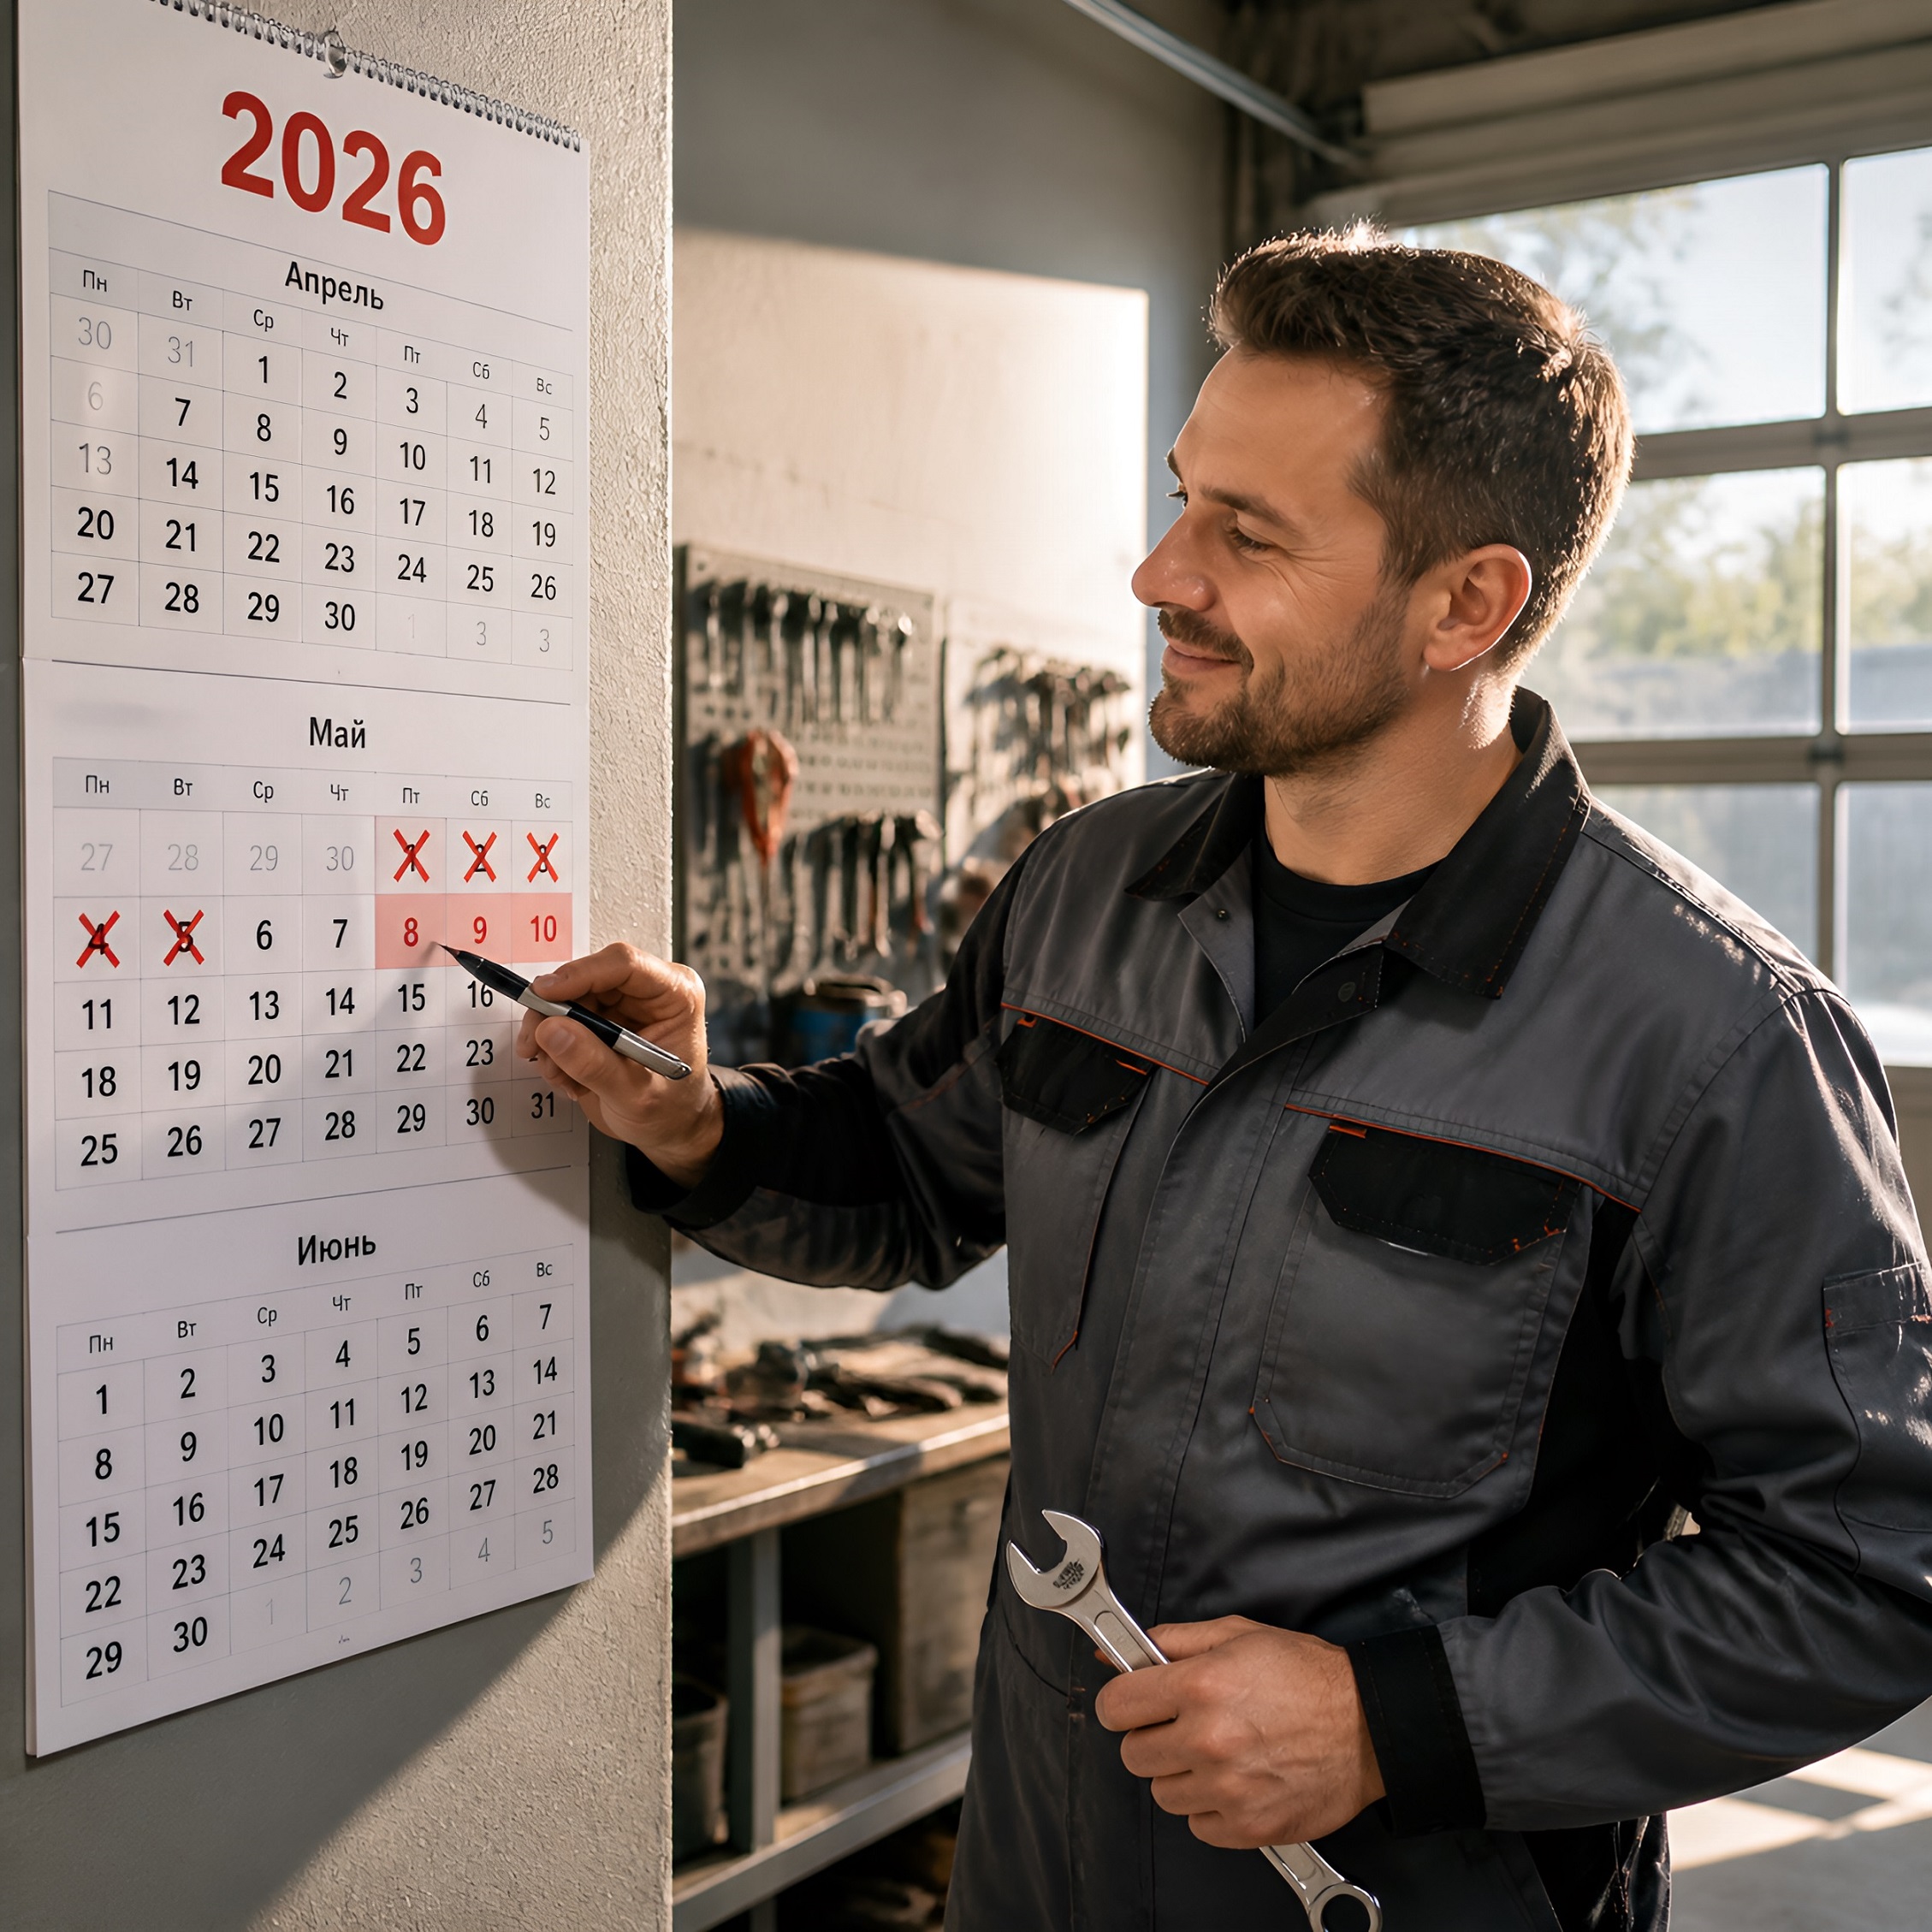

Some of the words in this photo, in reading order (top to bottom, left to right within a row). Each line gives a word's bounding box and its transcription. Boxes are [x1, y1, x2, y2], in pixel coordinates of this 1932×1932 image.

[222, 92, 445, 246] 2026
[84, 270, 107, 292] Пн
[173, 291, 193, 311] Вт
[254, 309, 273, 332] Ср
[331, 328, 348, 347] Чт
[405, 346, 420, 363] Пт
[473, 362, 489, 379] Сб
[537, 378, 551, 394] Вс
[285, 262, 383, 310] Апрель
[79, 317, 111, 349] 30
[169, 336, 193, 367] 31
[258, 356, 267, 383] 1
[334, 371, 347, 399] 2
[406, 388, 418, 413] 3
[476, 404, 487, 429] 4
[540, 417, 549, 441] 5
[88, 382, 103, 411] 6
[175, 398, 191, 426] 7
[257, 413, 271, 442] 8
[334, 429, 347, 455] 9
[400, 442, 425, 470] 10
[470, 456, 490, 483] 11
[533, 469, 555, 495] 12
[79, 443, 111, 474] 13
[167, 458, 199, 489] 14
[250, 472, 279, 502] 15
[327, 485, 354, 514] 16
[400, 498, 425, 525] 17
[469, 510, 493, 537] 18
[533, 521, 555, 547] 19
[78, 507, 114, 540] 20
[166, 519, 195, 552] 21
[248, 531, 280, 563] 22
[325, 543, 354, 572] 23
[398, 554, 426, 583] 24
[467, 565, 493, 592] 25
[531, 574, 556, 600] 26
[78, 572, 114, 603] 27
[165, 582, 199, 613] 28
[248, 592, 279, 622] 29
[325, 602, 355, 631] 30
[477, 621, 486, 645] 3
[540, 629, 549, 652] 3
[310, 717, 364, 748] Май
[86, 775, 109, 793] Пн
[175, 779, 193, 796] Вт
[253, 781, 273, 803] Ср
[331, 785, 348, 801] Чт
[403, 788, 419, 803] Пт
[471, 791, 488, 806] Сб
[536, 793, 550, 808] Вс
[81, 843, 113, 871] 27
[168, 845, 199, 870] 28
[251, 845, 278, 871] 29
[327, 846, 353, 871] 30
[87, 923, 109, 955] 4
[257, 920, 272, 950] 6
[333, 919, 347, 948] 7
[404, 917, 418, 947] 8
[473, 916, 487, 944] 9
[530, 916, 556, 942] 10
[82, 999, 110, 1029] 11
[168, 994, 199, 1025] 12
[250, 991, 279, 1020] 13
[326, 987, 355, 1016] 14
[398, 984, 425, 1012] 15
[468, 981, 494, 1008] 16
[82, 1066, 116, 1098] 18
[169, 1060, 200, 1091] 19
[248, 1054, 281, 1085] 20
[325, 1049, 352, 1078] 21
[397, 1044, 425, 1072] 22
[466, 1039, 493, 1066] 23
[81, 1133, 117, 1166] 25
[168, 1125, 202, 1157] 26
[249, 1117, 281, 1148] 27
[325, 1111, 355, 1141] 28
[397, 1104, 425, 1133] 29
[466, 1098, 494, 1125] 30
[531, 1092, 554, 1118] 31
[299, 1235, 376, 1265] Июнь
[90, 1335, 113, 1353] Пн
[178, 1321, 196, 1338] Вт
[258, 1307, 276, 1326] Ср
[333, 1295, 351, 1311] Чт
[406, 1283, 423, 1300] Пт
[473, 1271, 489, 1287] Сб
[537, 1262, 552, 1277] Вс
[97, 1384, 107, 1414] 1
[181, 1368, 195, 1399] 2
[262, 1354, 276, 1383] 3
[335, 1340, 351, 1367] 4
[408, 1327, 420, 1354] 5
[477, 1315, 489, 1342] 6
[540, 1304, 551, 1330] 7
[95, 1449, 112, 1479] 8
[181, 1431, 196, 1461] 9
[254, 1413, 283, 1445] 10
[330, 1398, 353, 1428] 11
[401, 1384, 427, 1413] 12
[470, 1370, 495, 1398] 13
[534, 1357, 557, 1384] 14
[86, 1512, 120, 1547] 15
[173, 1492, 204, 1526] 16
[254, 1473, 284, 1506] 17
[330, 1457, 358, 1488] 18
[401, 1441, 428, 1470] 19
[469, 1425, 495, 1455] 20
[533, 1410, 554, 1439] 21
[86, 1576, 121, 1613] 22
[173, 1555, 205, 1590] 23
[253, 1534, 285, 1568] 24
[329, 1515, 358, 1548] 25
[400, 1497, 429, 1529] 26
[470, 1479, 495, 1510] 27
[533, 1464, 559, 1493] 28
[86, 1641, 121, 1680] 29
[174, 1617, 207, 1652] 30
[339, 1577, 351, 1604] 2
[411, 1557, 422, 1583] 3
[478, 1538, 490, 1562] 4
[542, 1520, 553, 1544] 5
